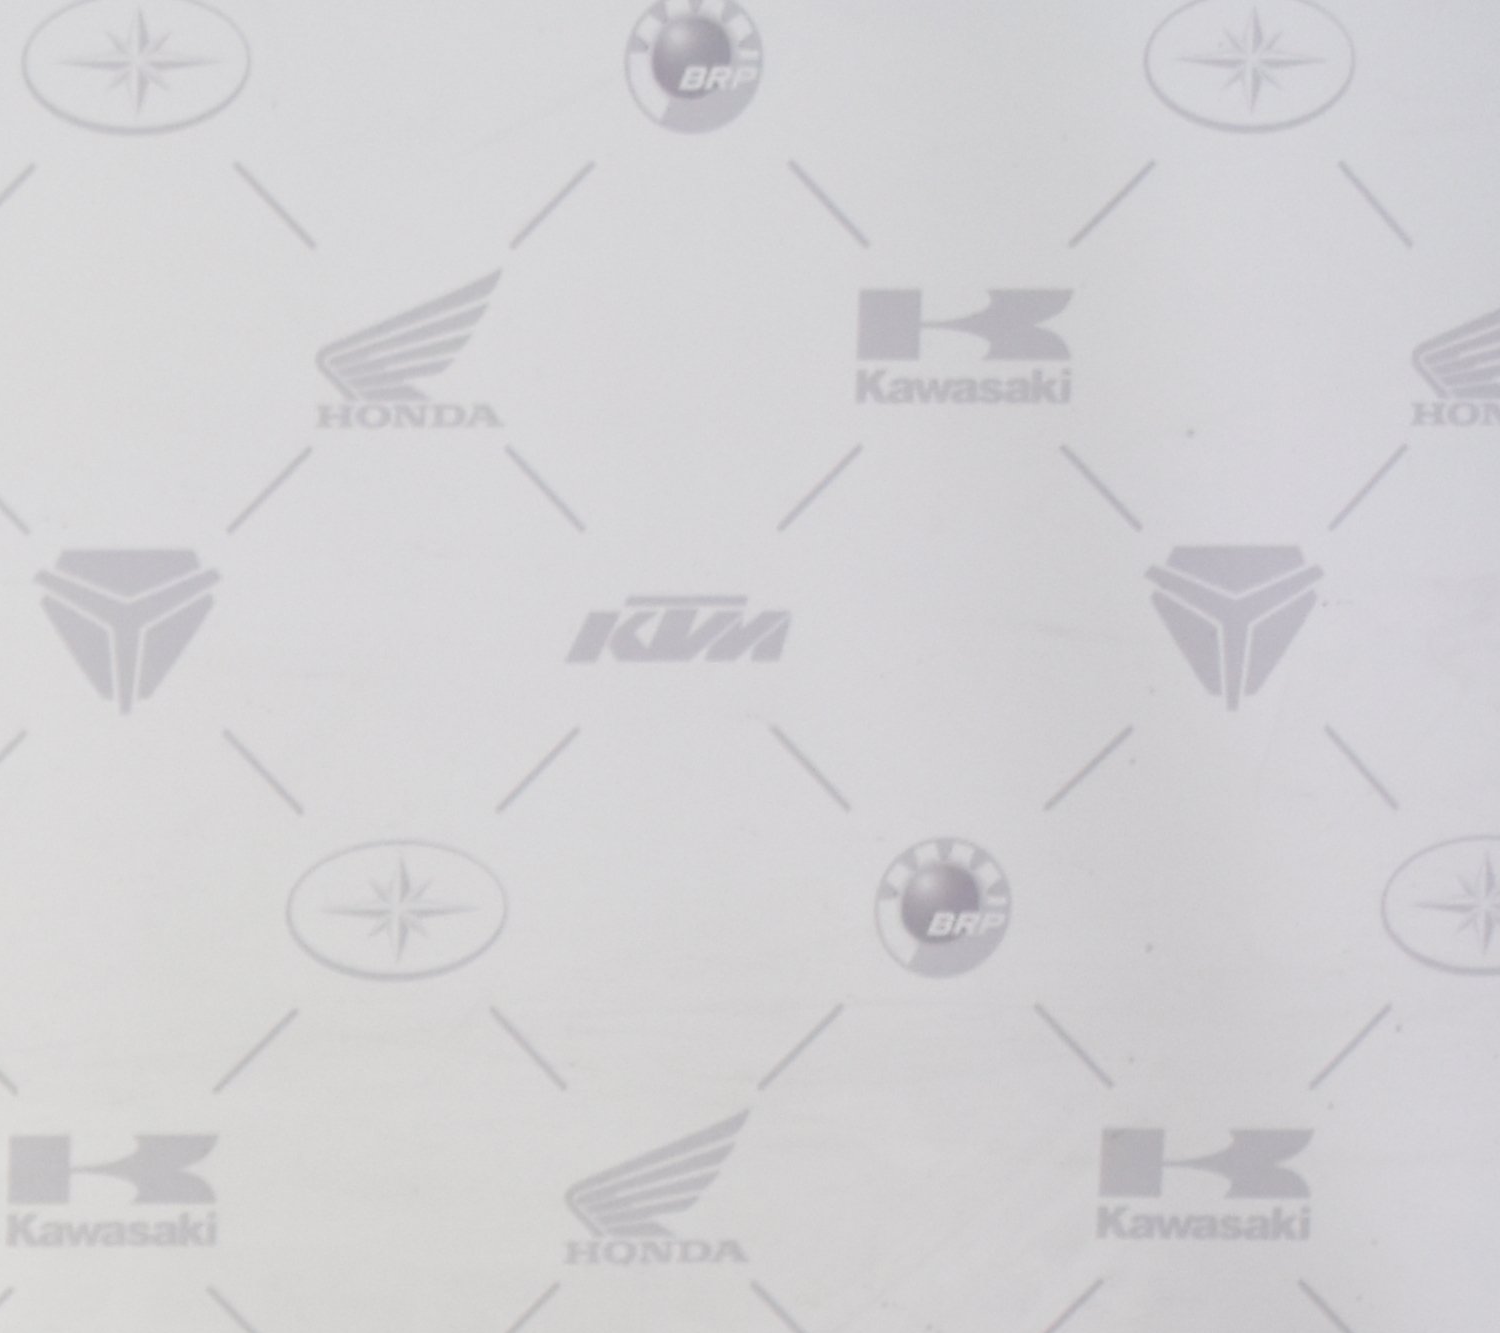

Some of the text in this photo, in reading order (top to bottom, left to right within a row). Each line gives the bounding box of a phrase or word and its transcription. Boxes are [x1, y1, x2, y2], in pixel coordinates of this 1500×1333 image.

[679, 65, 758, 92] BRP
[856, 368, 1072, 404] Kawasaki
[316, 404, 502, 428] HONDA
[566, 595, 791, 662] KTM
[928, 912, 1006, 939] BRP
[6, 1211, 218, 1247] Kawasaki
[1097, 1206, 1311, 1241] Kawasaki
[565, 1240, 749, 1265] HONDA
